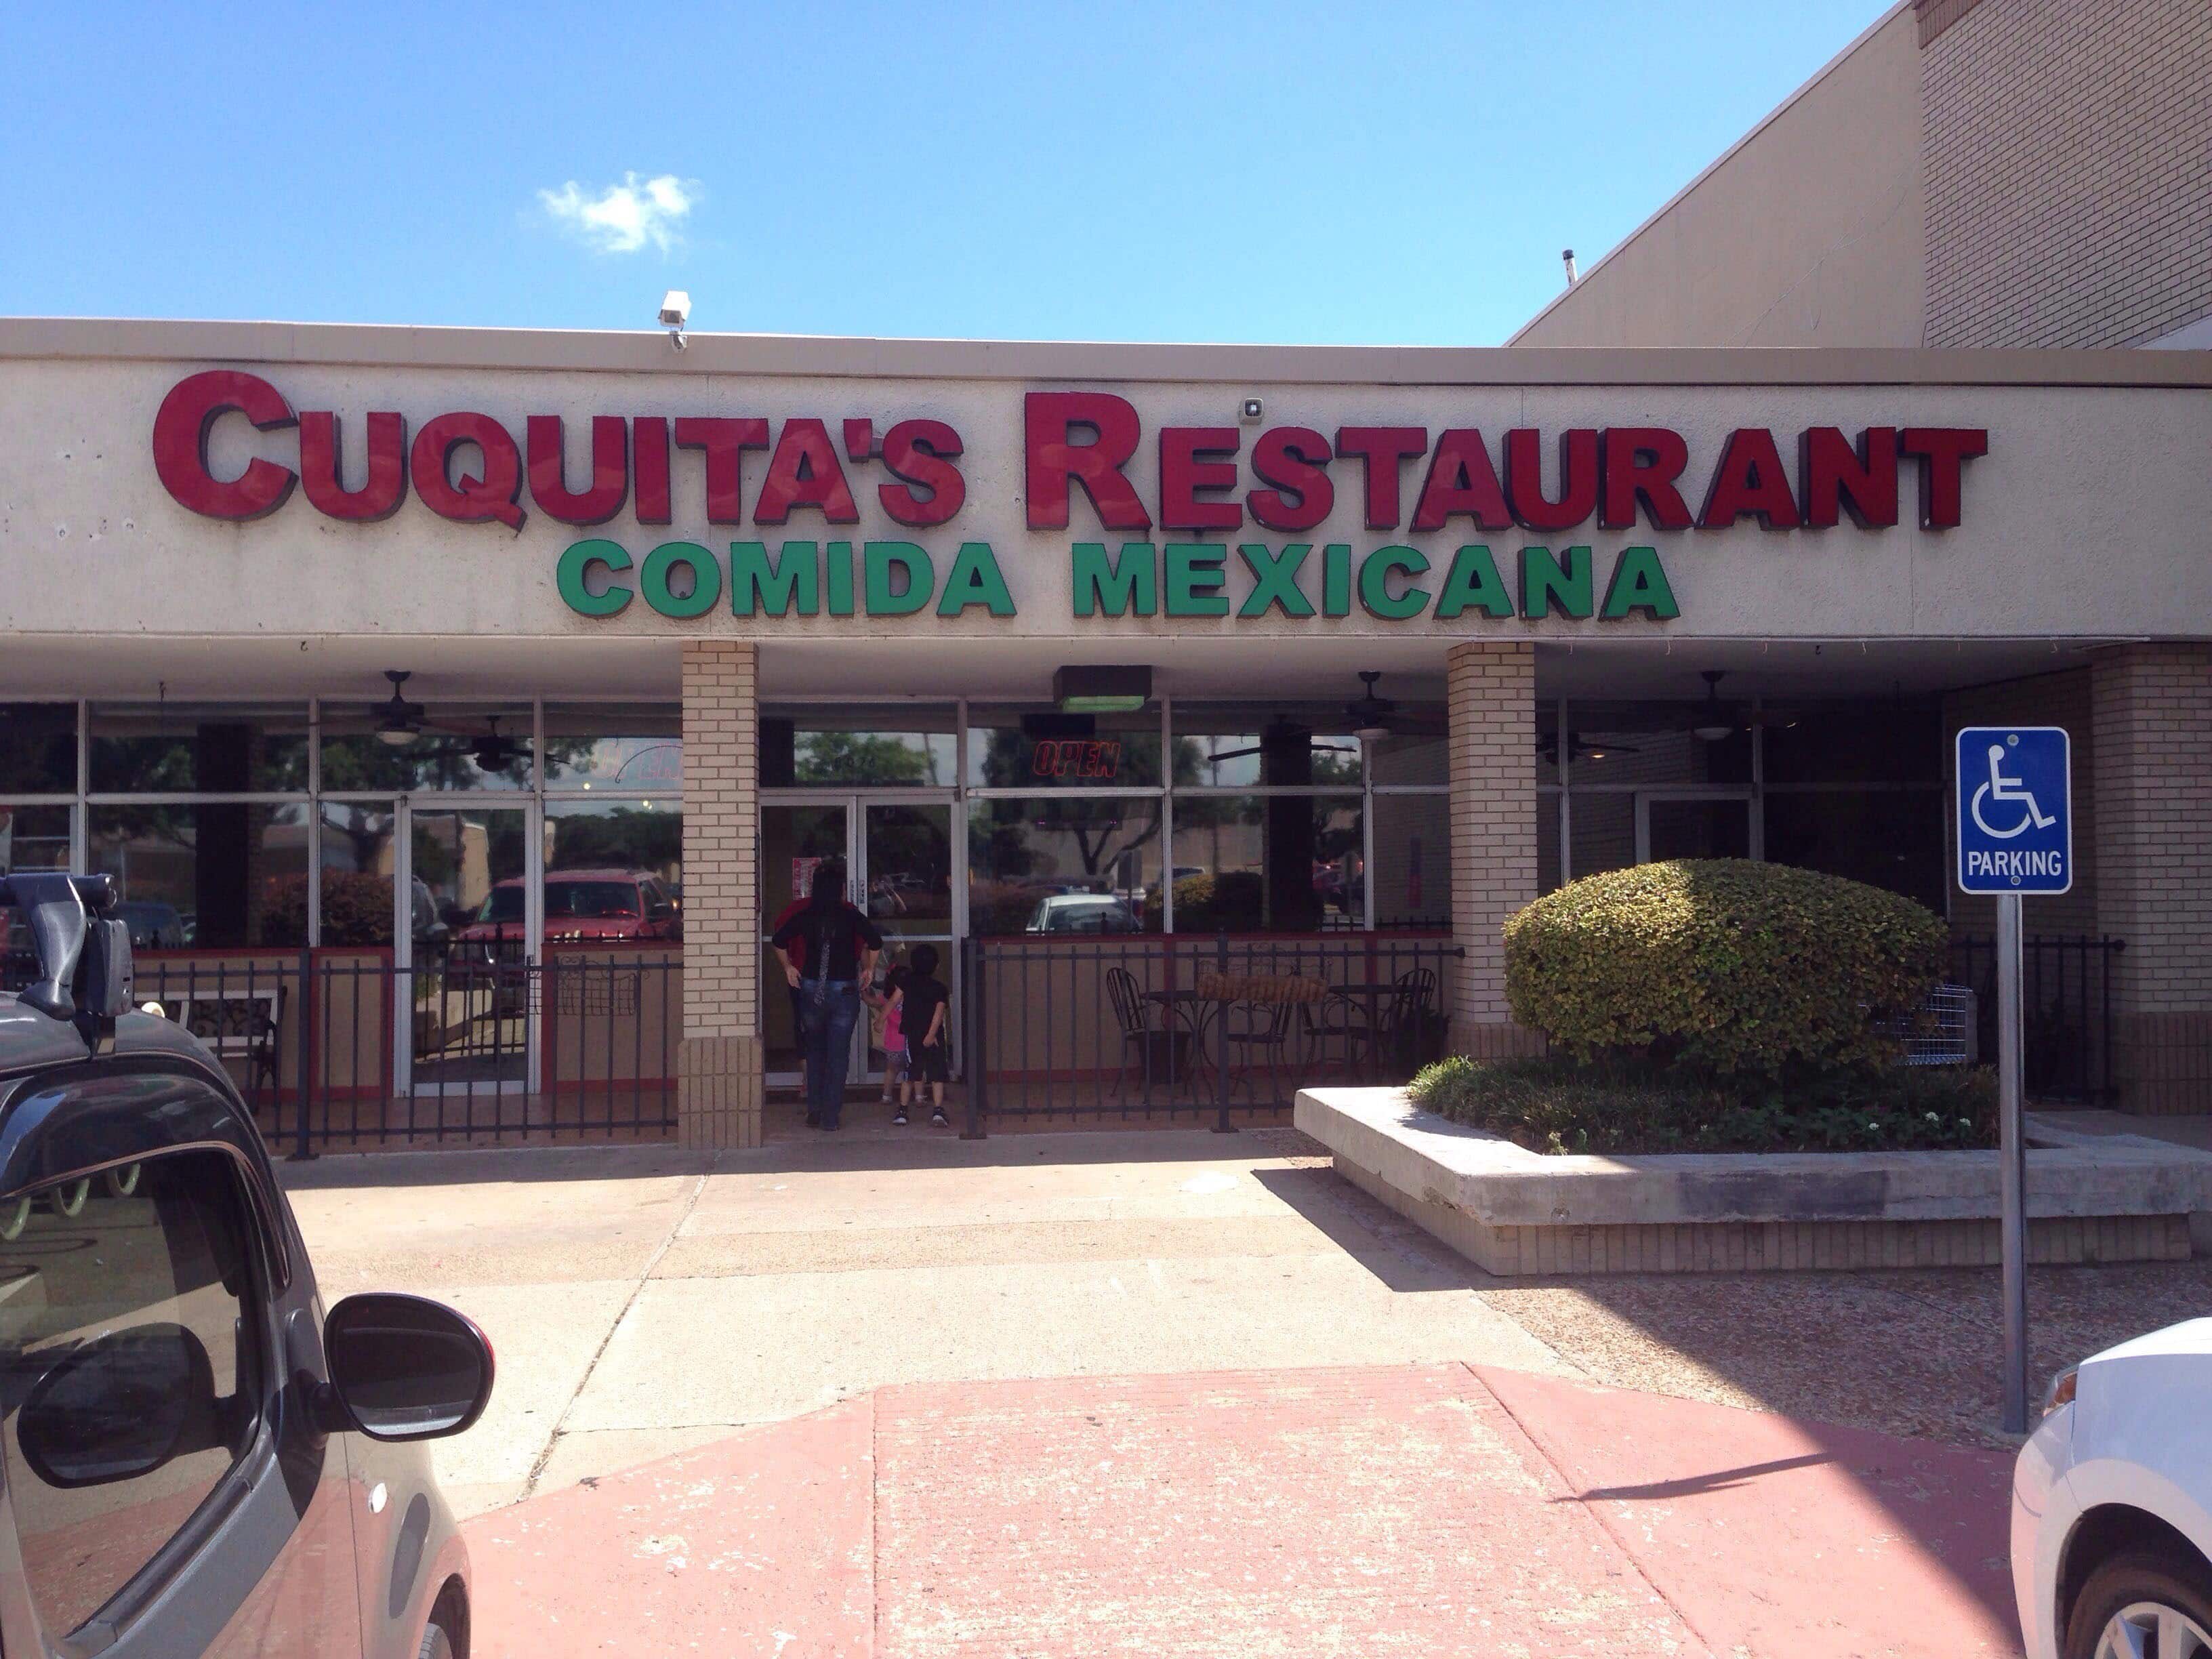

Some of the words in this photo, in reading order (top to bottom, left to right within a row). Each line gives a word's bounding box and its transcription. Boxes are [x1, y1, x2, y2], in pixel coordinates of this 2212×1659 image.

[152, 370, 966, 534] CUQUITA'S
[1024, 392, 1990, 532] RESTAURANT
[556, 539, 1015, 619] COMIDA
[1072, 542, 1680, 621] MEXICANA
[1033, 739, 1121, 778] OPEN
[1968, 851, 2062, 876] PARKING
